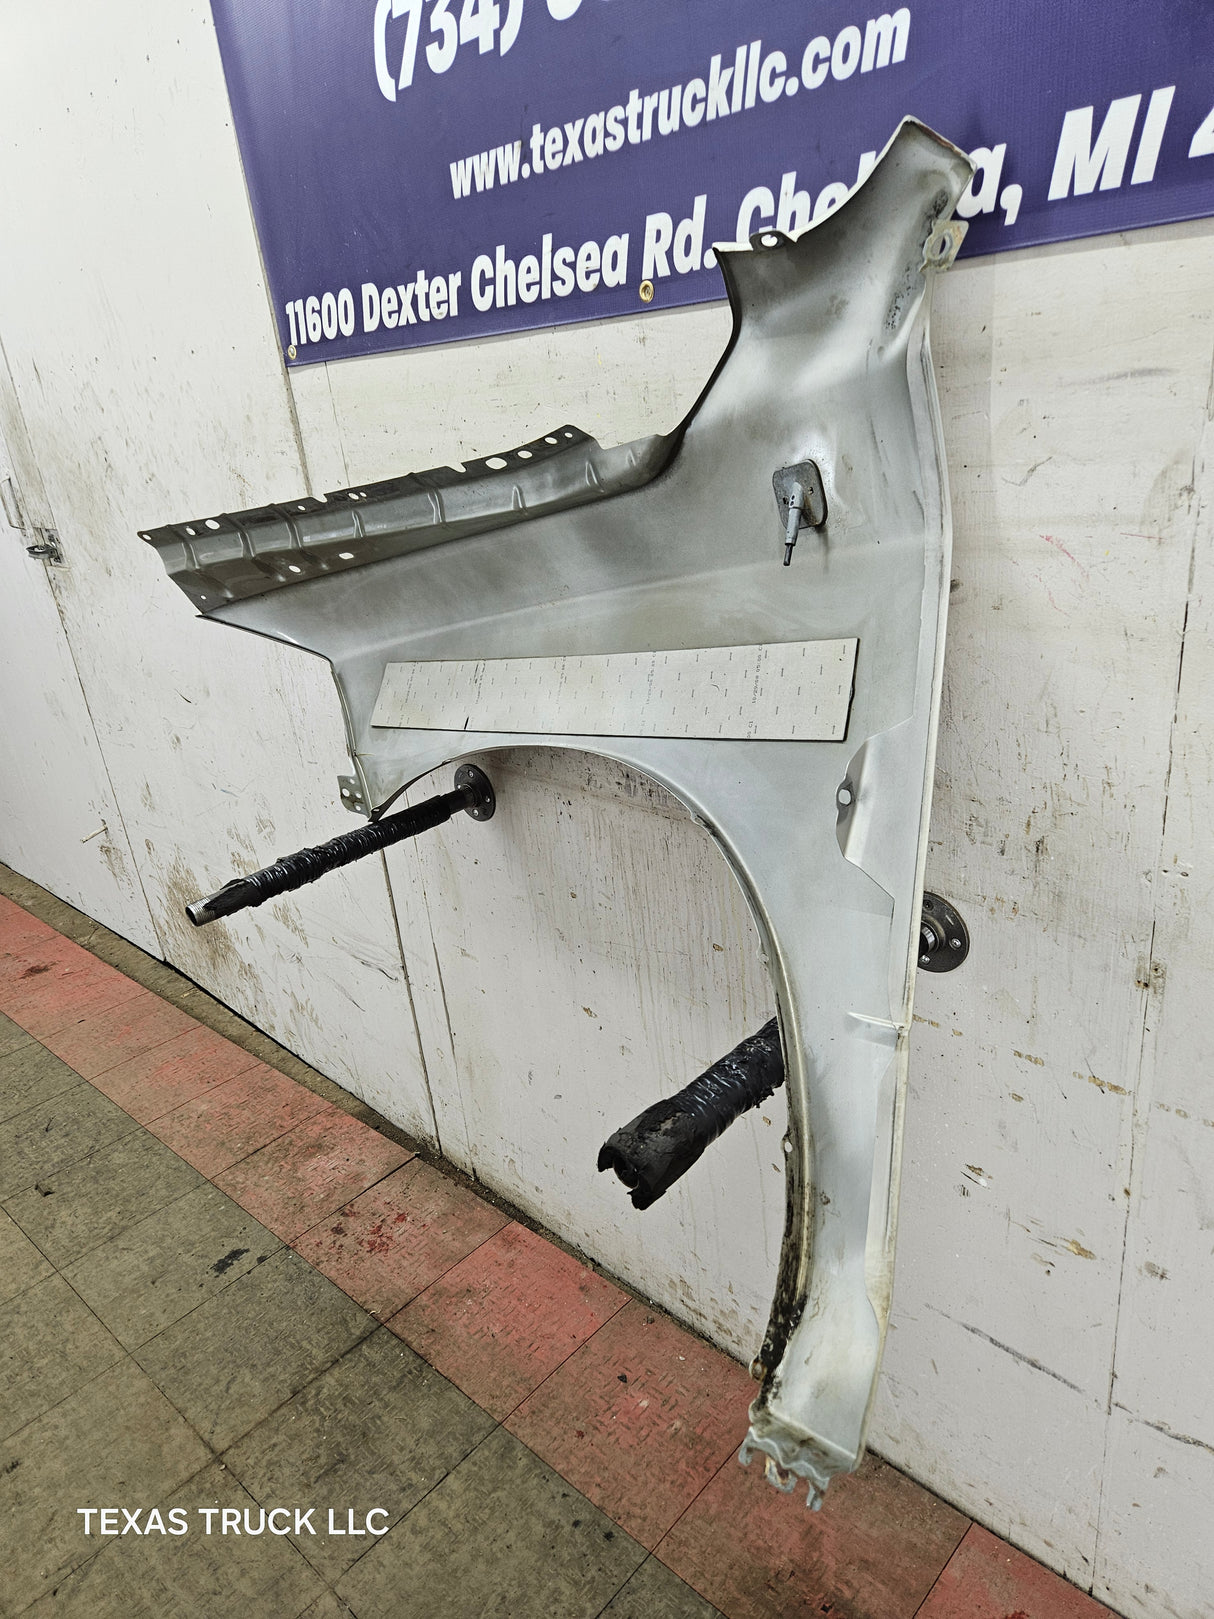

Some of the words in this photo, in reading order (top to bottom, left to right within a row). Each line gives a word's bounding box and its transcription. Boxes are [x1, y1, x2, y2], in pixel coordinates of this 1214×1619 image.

[285, 287, 355, 346] 11600
[361, 270, 462, 333] Dexter
[470, 233, 630, 312] Chelsea
[641, 193, 717, 281] Rd.
[735, 143, 1023, 243] Chea,
[1047, 85, 1176, 201] MI
[449, 7, 911, 200] www.texastruckllc.com
